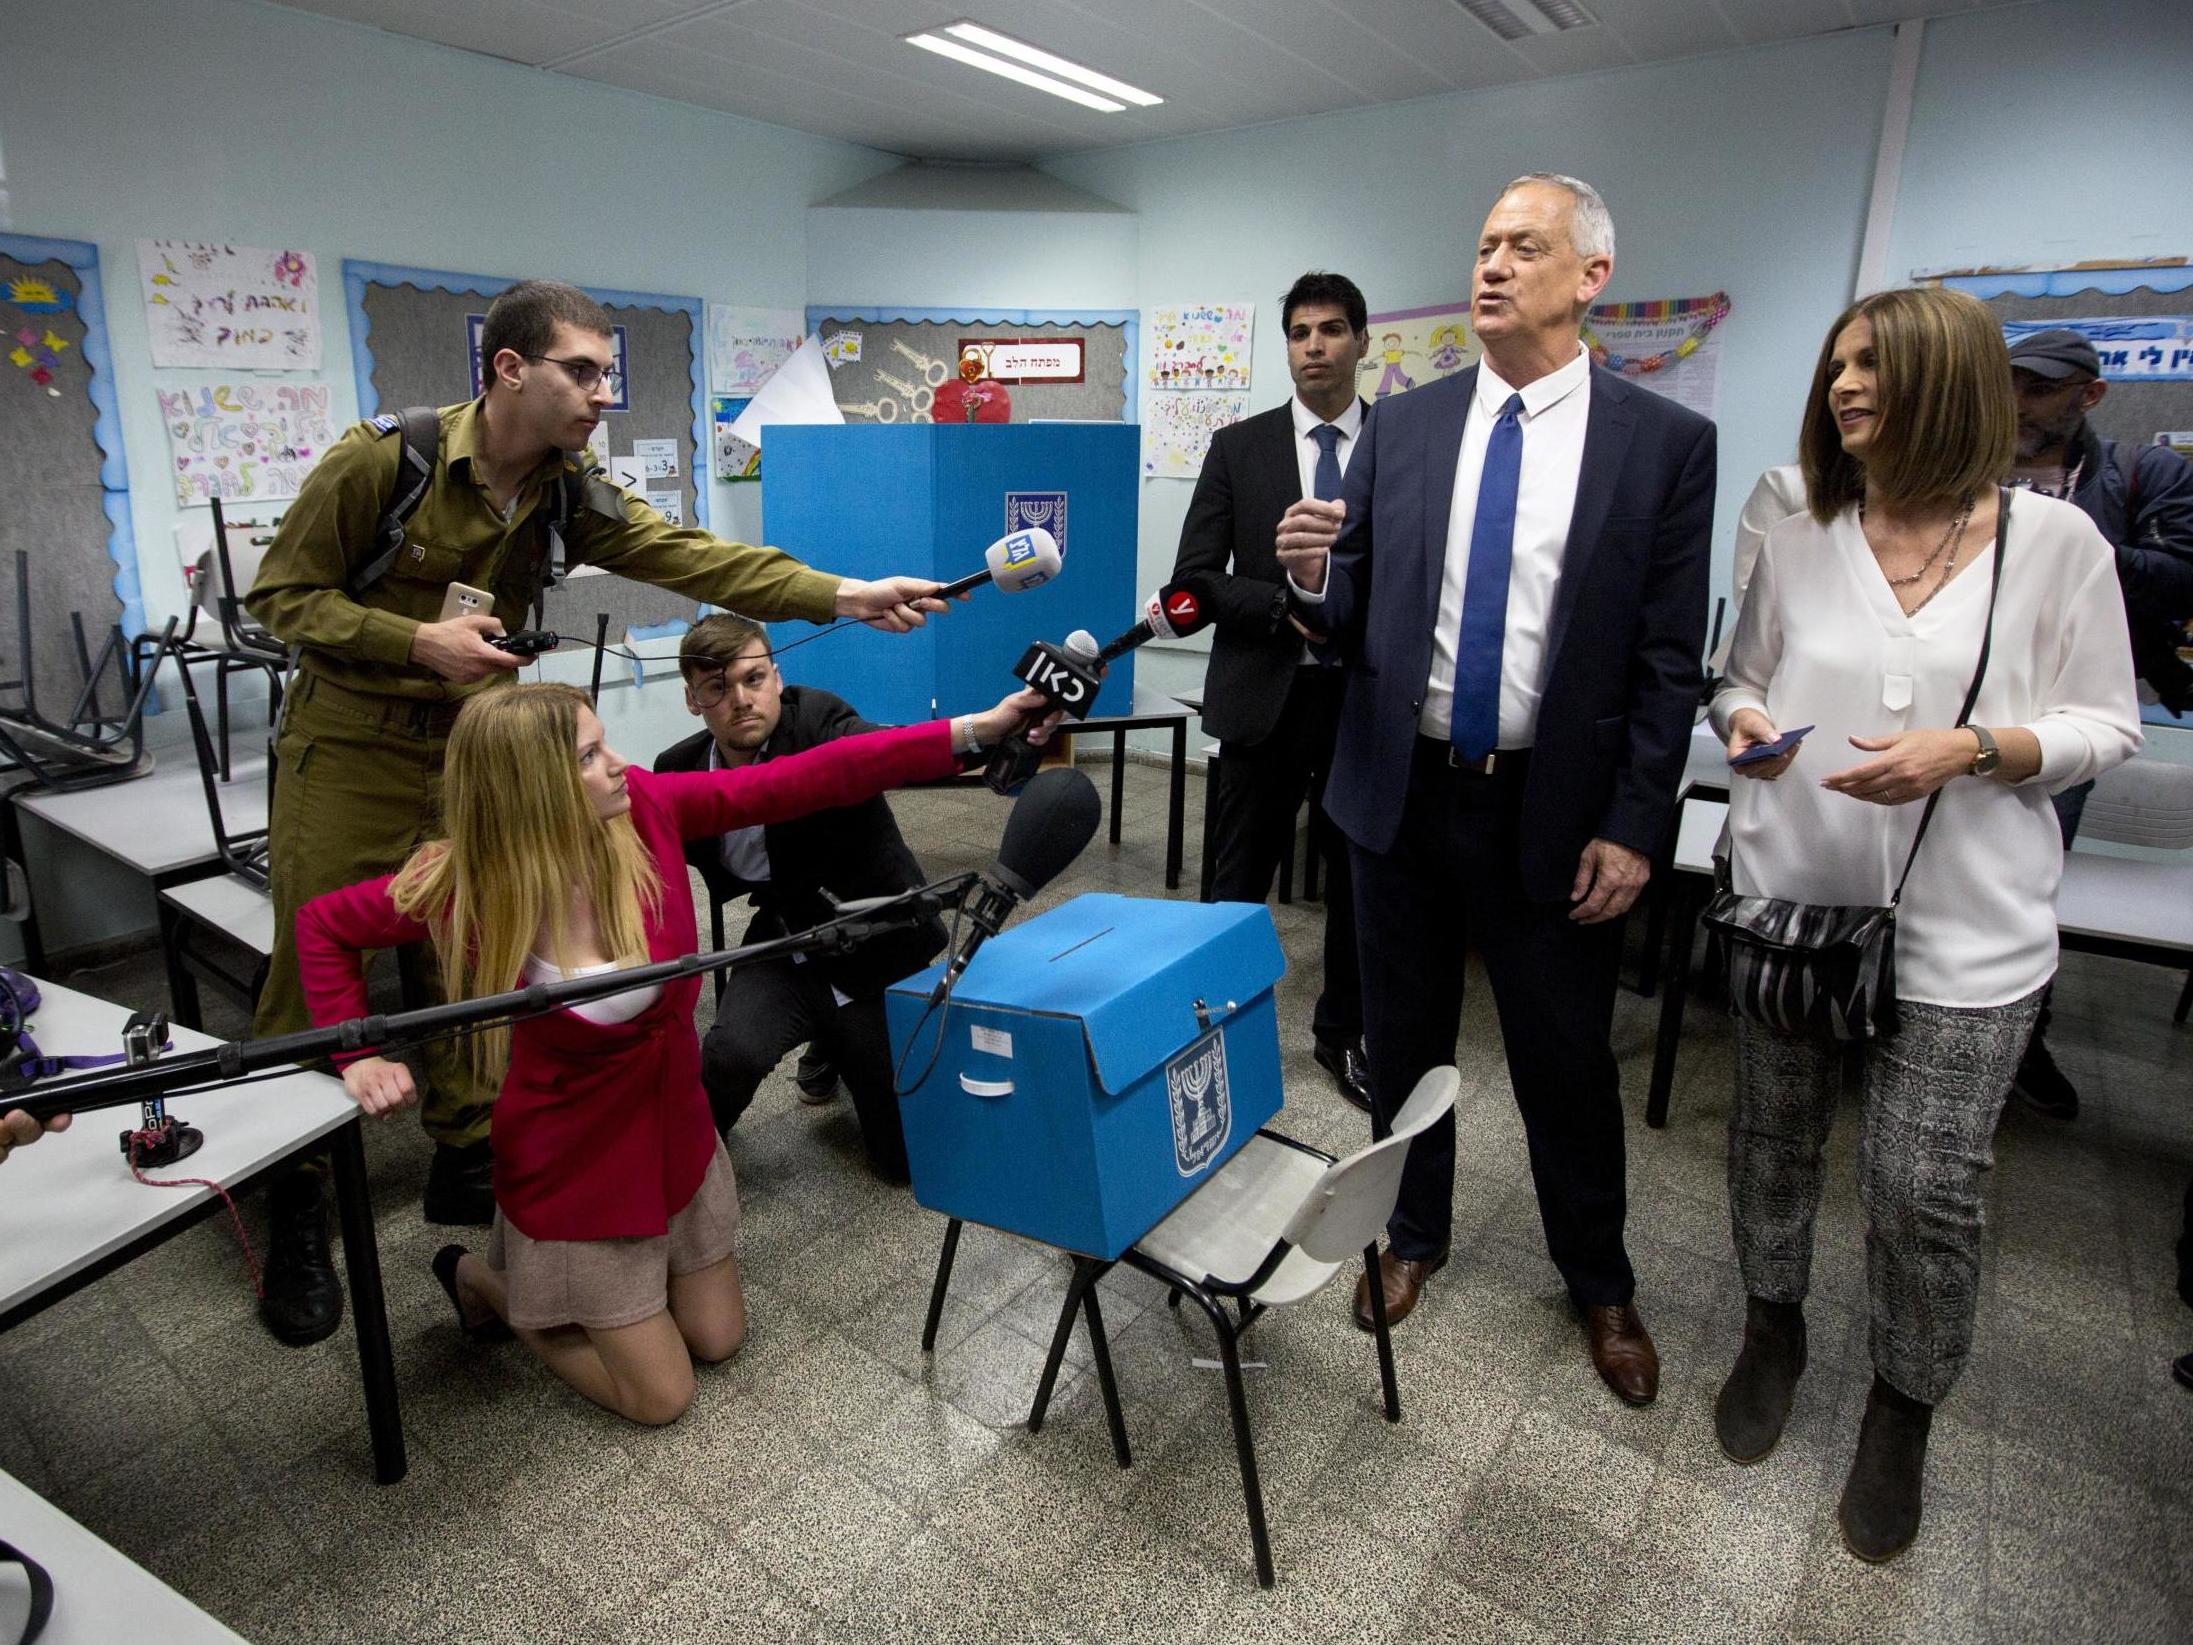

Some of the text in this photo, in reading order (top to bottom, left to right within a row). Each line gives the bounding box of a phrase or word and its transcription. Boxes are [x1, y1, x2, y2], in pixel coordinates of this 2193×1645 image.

[1606, 330, 1632, 338] ספרי
[1635, 330, 1652, 338] בית
[1005, 356, 1060, 368] מפתח הלב
[2098, 350, 2128, 367] אר
[2139, 345, 2163, 366] לי
[1024, 651, 1085, 703] כאן
